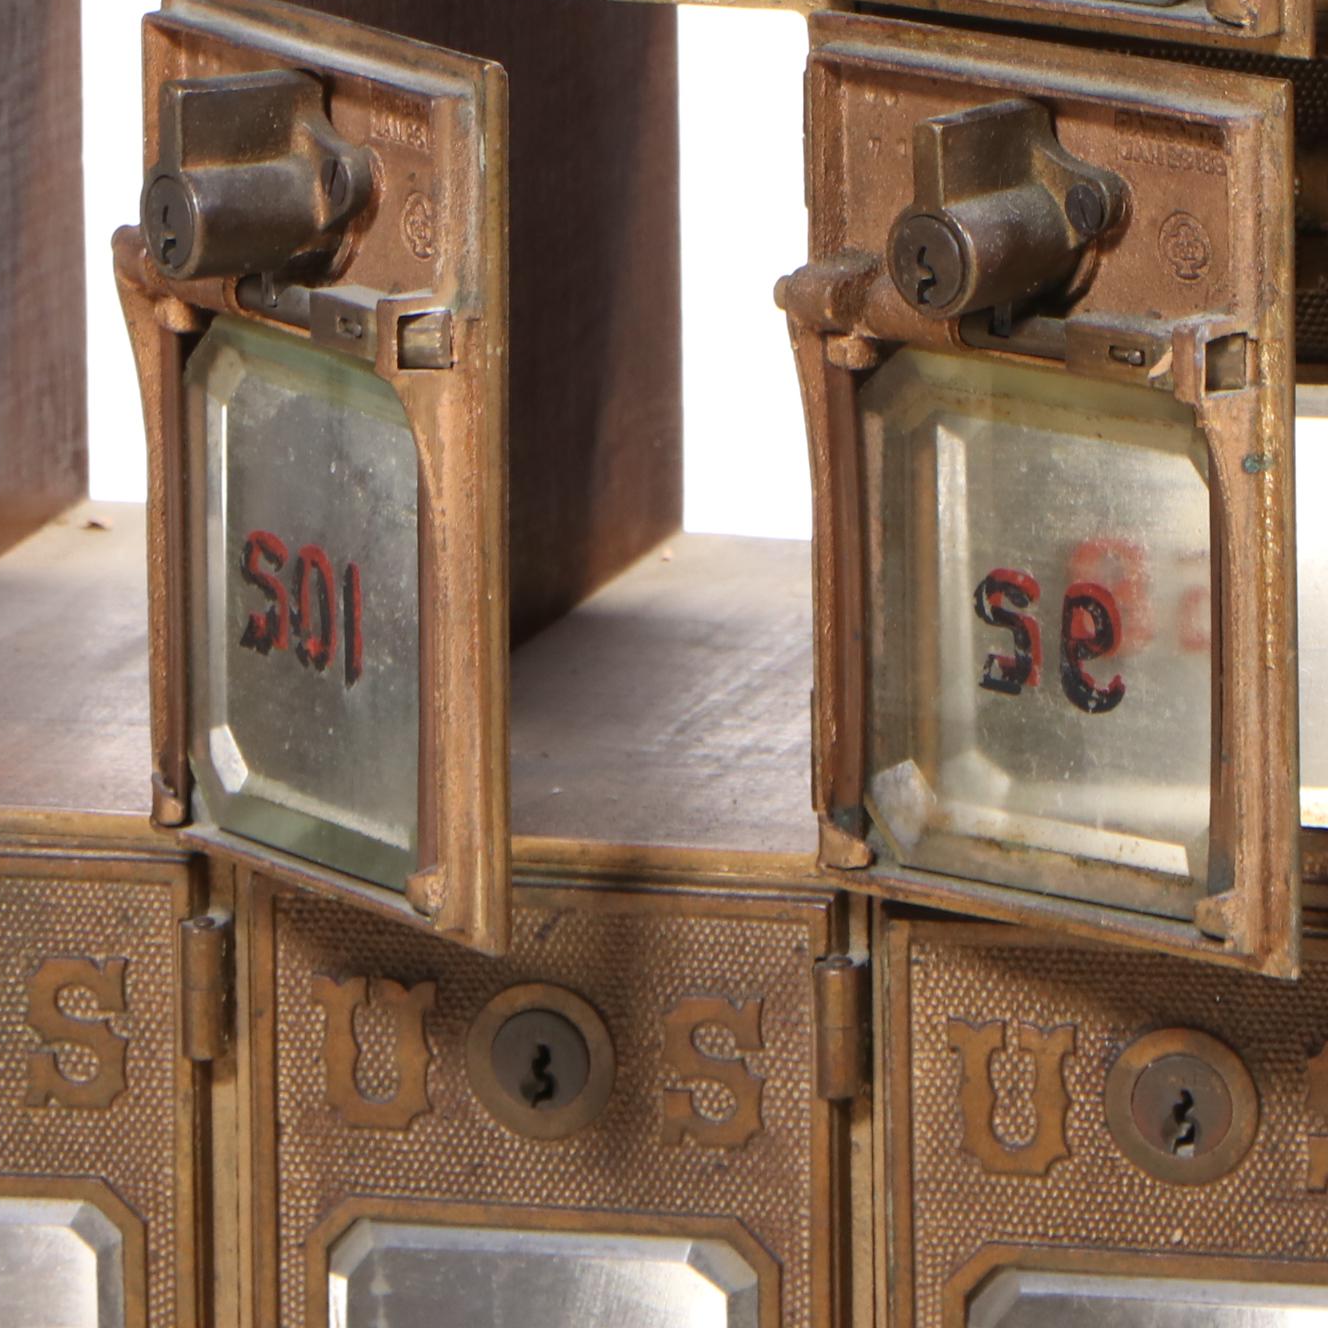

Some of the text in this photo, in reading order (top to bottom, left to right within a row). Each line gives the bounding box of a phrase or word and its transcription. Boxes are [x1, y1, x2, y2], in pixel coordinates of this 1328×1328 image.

[25, 954, 130, 1110] S
[310, 971, 766, 1150] U S
[946, 1016, 1079, 1178] U
